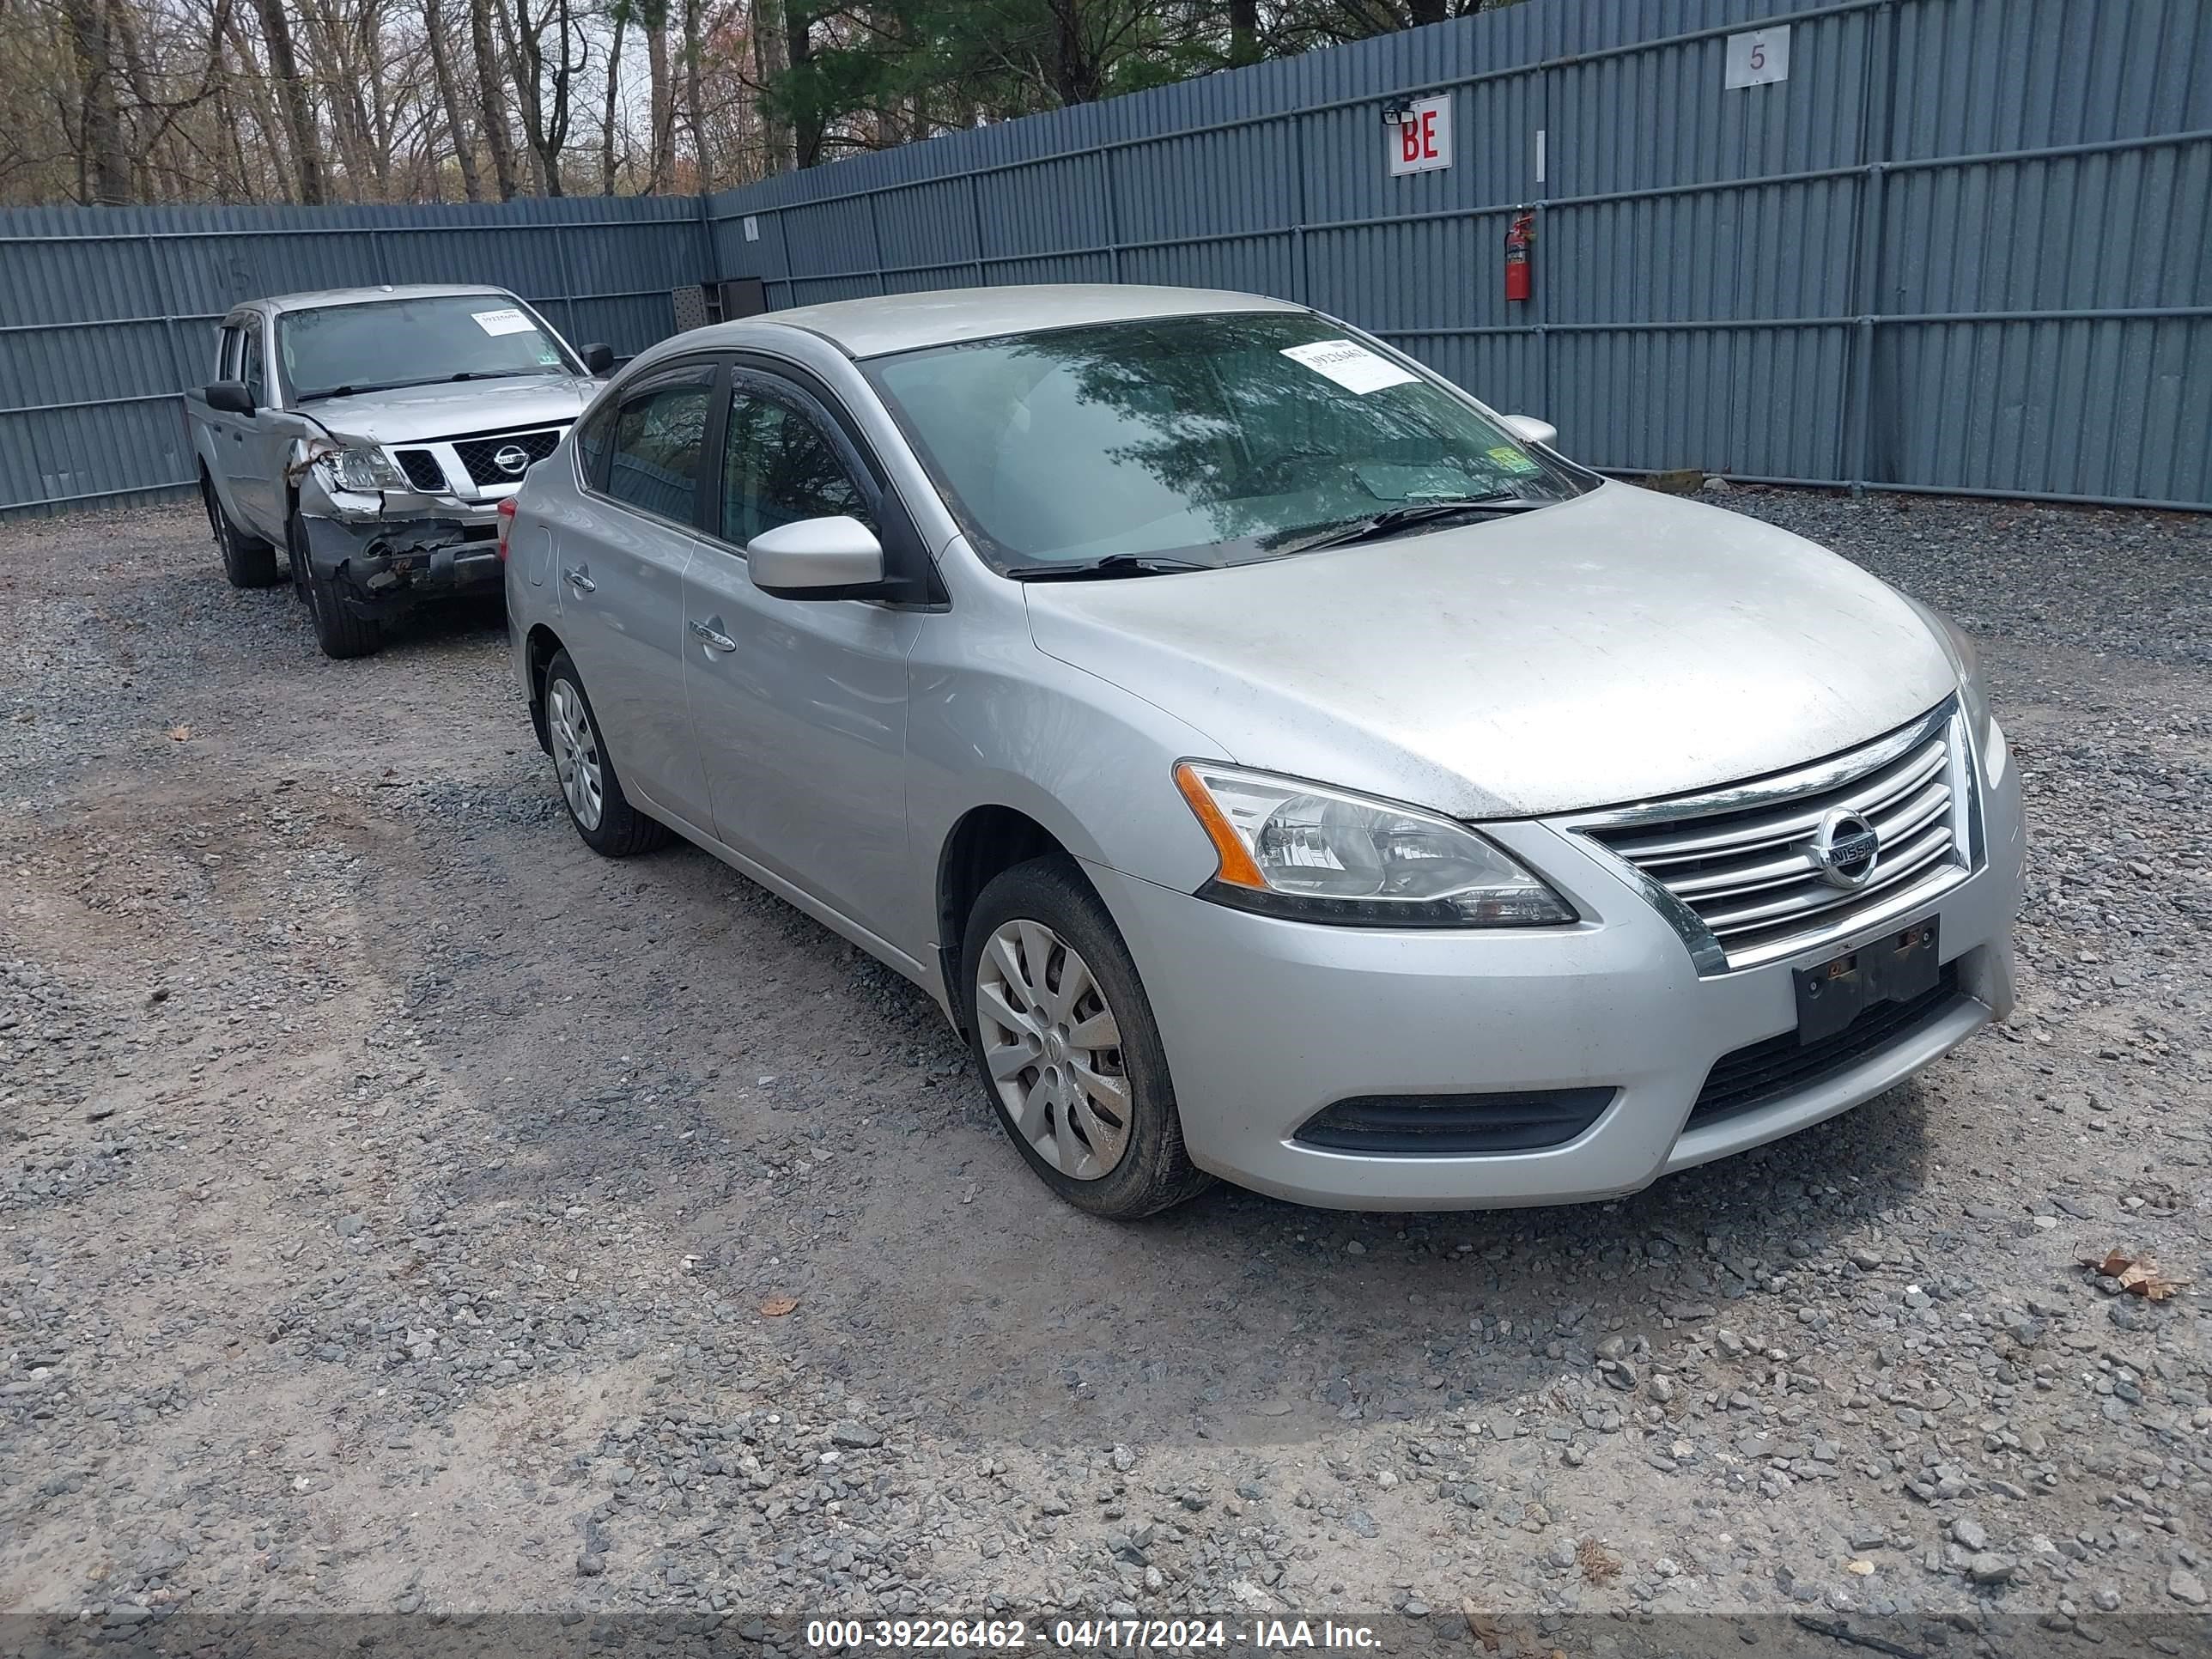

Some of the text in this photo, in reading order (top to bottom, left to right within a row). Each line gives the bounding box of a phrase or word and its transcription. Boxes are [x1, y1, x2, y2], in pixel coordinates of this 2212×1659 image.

[1750, 43, 1765, 70] 5
[1401, 110, 1438, 163] BE
[1306, 349, 1369, 367] 39226462
[1831, 836, 1878, 863] NISSAN
